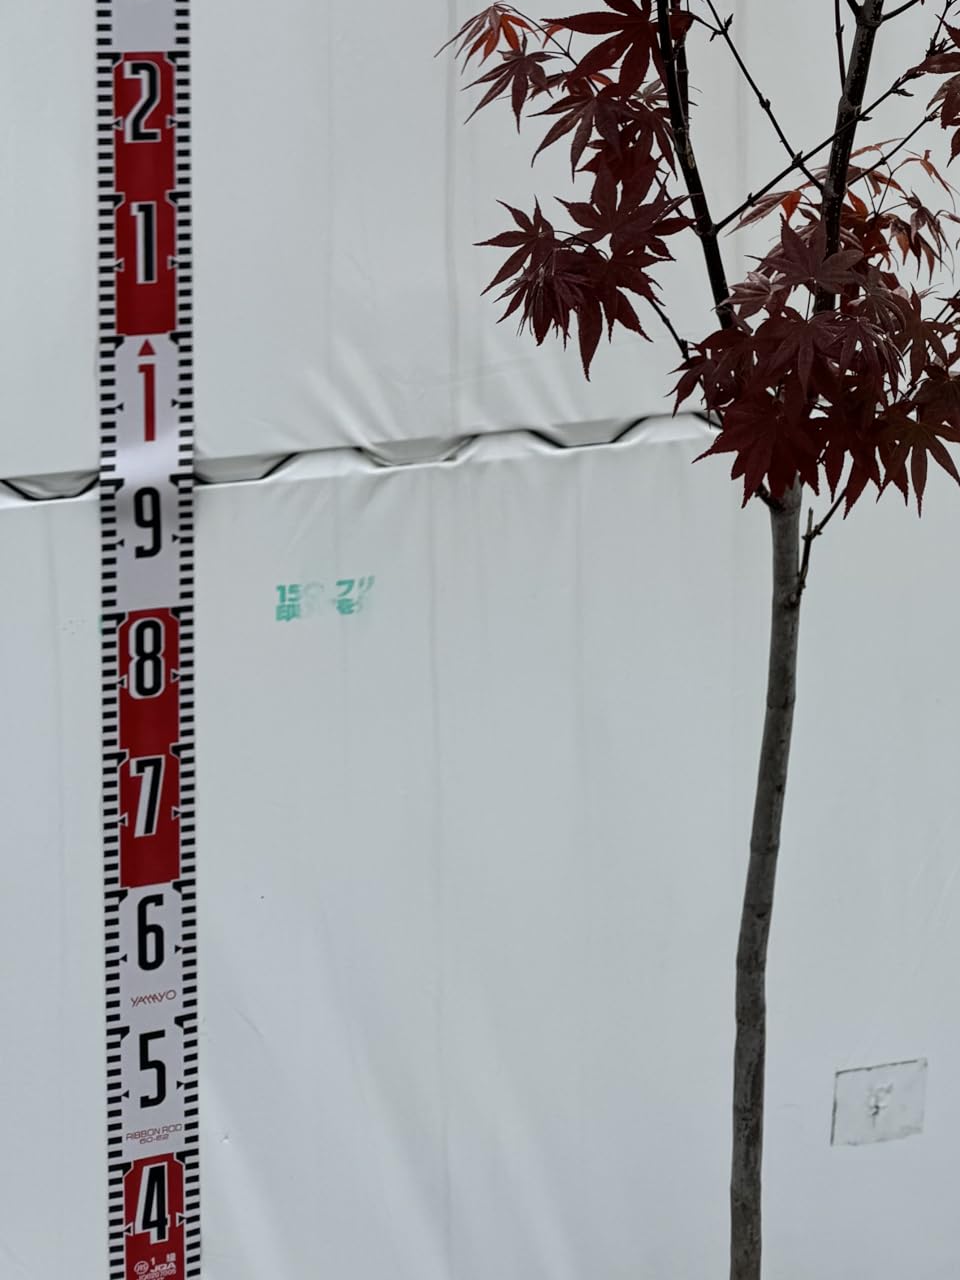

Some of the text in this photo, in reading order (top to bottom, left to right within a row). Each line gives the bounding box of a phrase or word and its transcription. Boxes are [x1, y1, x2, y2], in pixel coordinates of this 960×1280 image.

[123, 60, 162, 144] 2
[130, 201, 157, 285] 1
[138, 363, 156, 442] 1
[133, 486, 162, 559] 9
[128, 617, 165, 700] 8
[129, 754, 165, 838] 7
[137, 893, 164, 971] 6
[139, 1029, 166, 1108] 5
[126, 1123, 183, 1140] RIBBON ROD
[134, 1161, 171, 1245] 4
